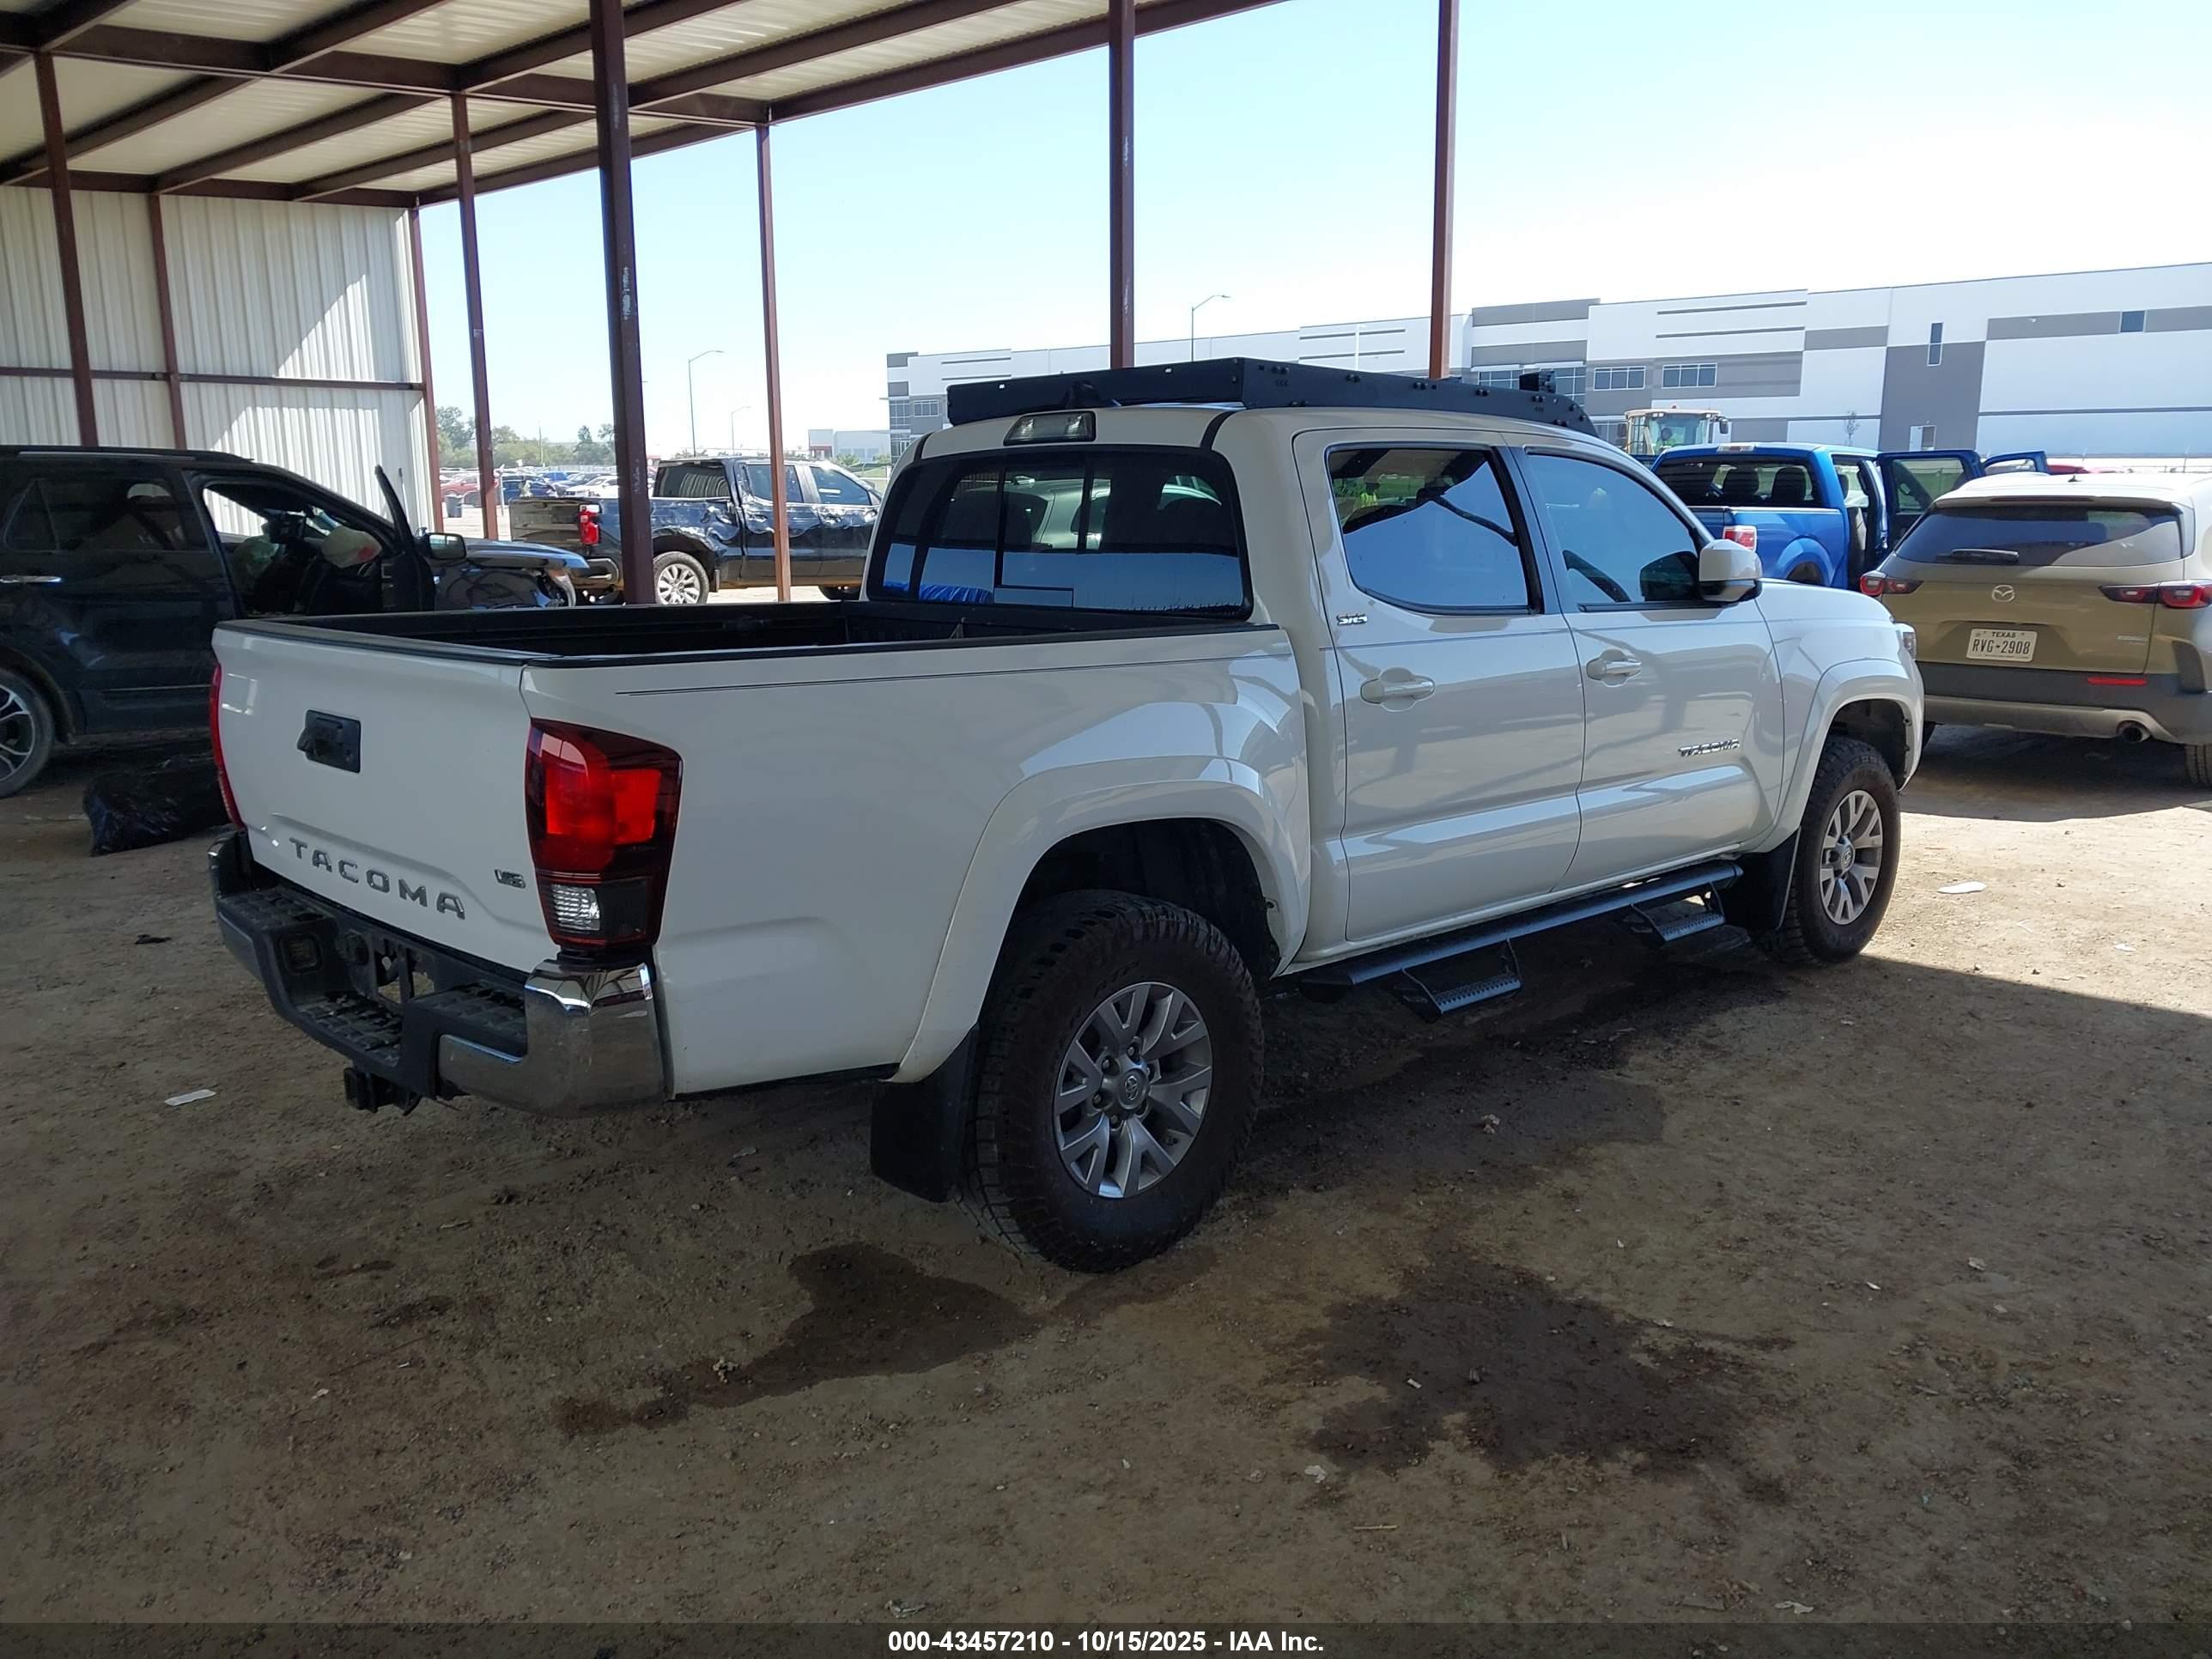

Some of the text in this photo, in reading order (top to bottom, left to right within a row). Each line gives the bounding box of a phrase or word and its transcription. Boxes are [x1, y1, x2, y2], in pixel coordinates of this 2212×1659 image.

[1677, 738, 1740, 757] TACOMA
[289, 836, 465, 921] TACOMA
[494, 869, 526, 890] V6
